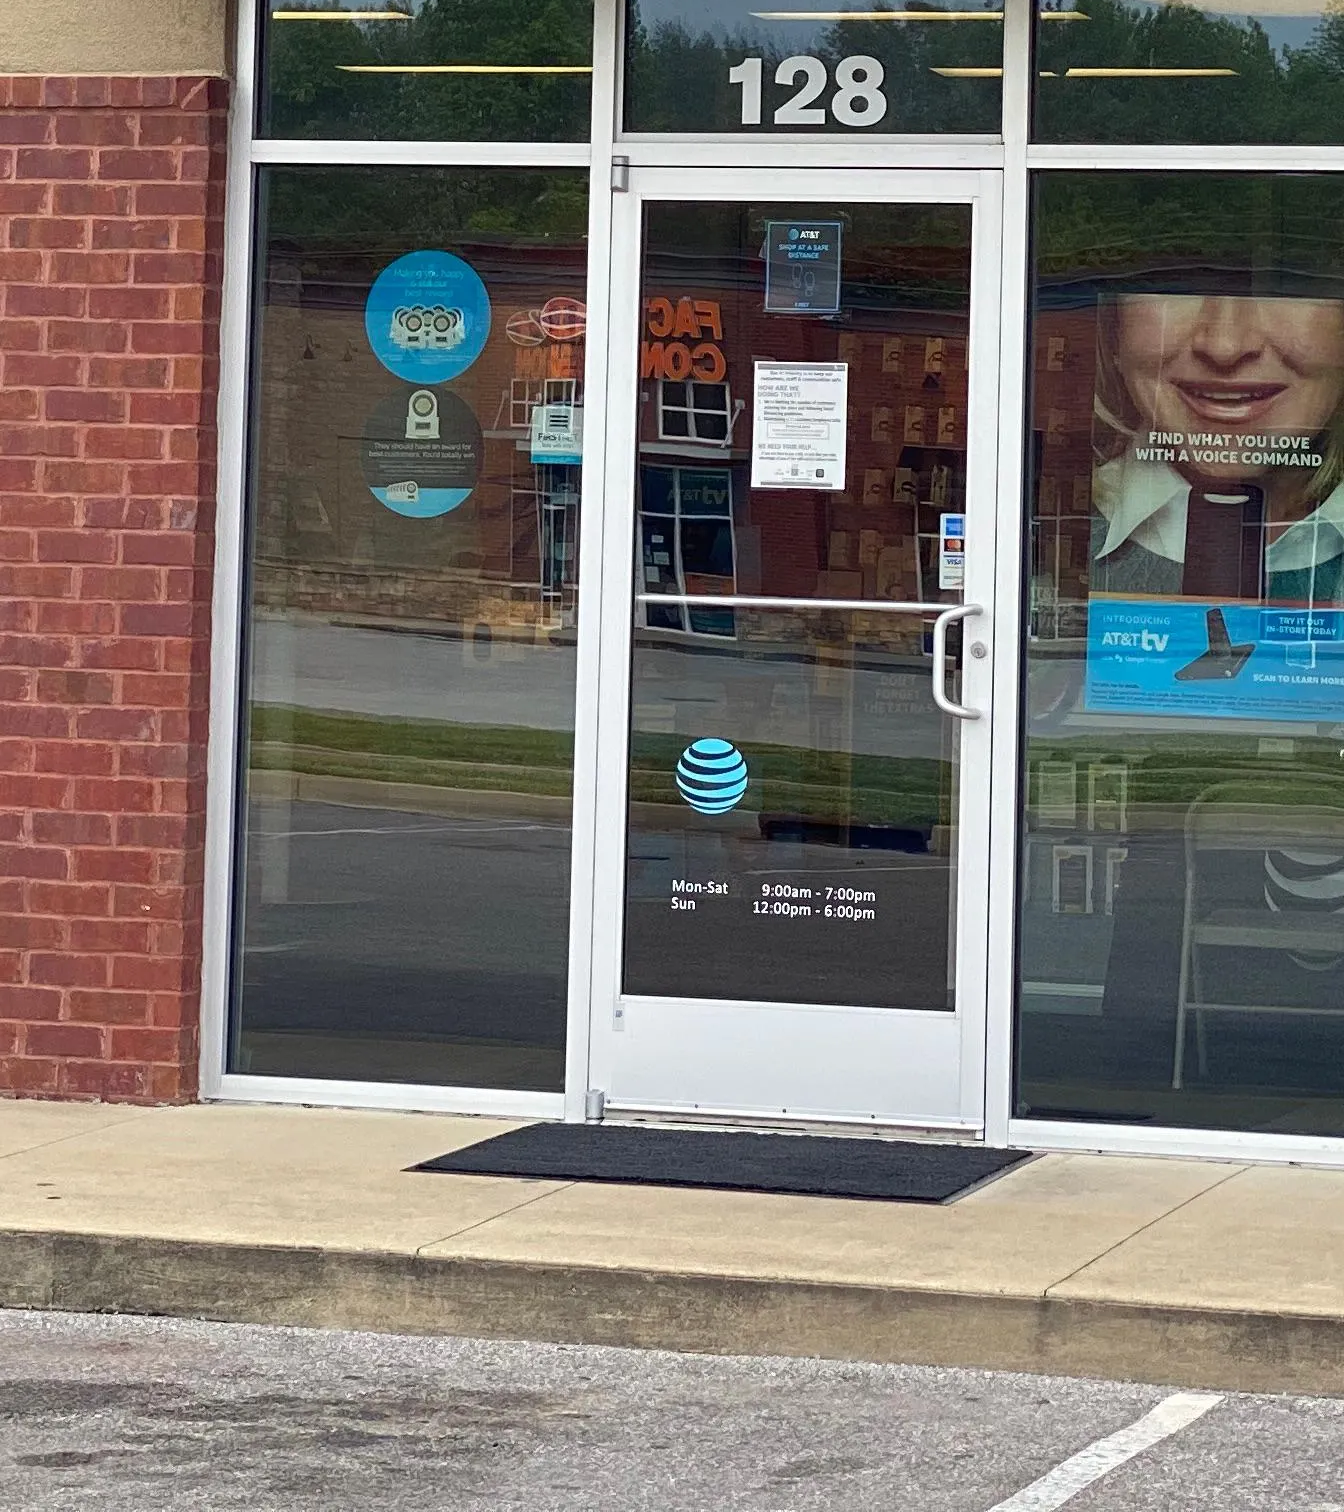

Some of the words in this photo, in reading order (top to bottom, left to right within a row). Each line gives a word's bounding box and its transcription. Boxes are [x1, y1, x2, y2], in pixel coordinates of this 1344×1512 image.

[729, 55, 887, 127] 128
[800, 231, 820, 239] AT&T
[1148, 432, 1184, 445] FIND
[1187, 433, 1232, 446] WHAT
[1235, 435, 1266, 448] YOU
[1270, 436, 1310, 449] LOVE
[1135, 447, 1175, 462] WITH
[1178, 449, 1189, 462] A
[1193, 450, 1238, 464] VOICE
[1241, 451, 1323, 467] COMMAND
[1103, 615, 1171, 625] INTRODUCING
[1279, 617, 1296, 625] TRY
[1297, 617, 1306, 625] IT
[1307, 618, 1325, 626] OUT
[1102, 632, 1141, 646] AT&T
[1253, 674, 1276, 682] SCAN
[1278, 675, 1290, 683] TO
[1291, 675, 1319, 684] LEARN
[672, 880, 728, 895] Mon-Sat
[761, 884, 812, 899] 9:00am
[825, 888, 876, 903] 7:00pm
[671, 897, 696, 910] Sun
[752, 901, 811, 918] 12:00pm
[824, 905, 875, 921] 6:00pm
